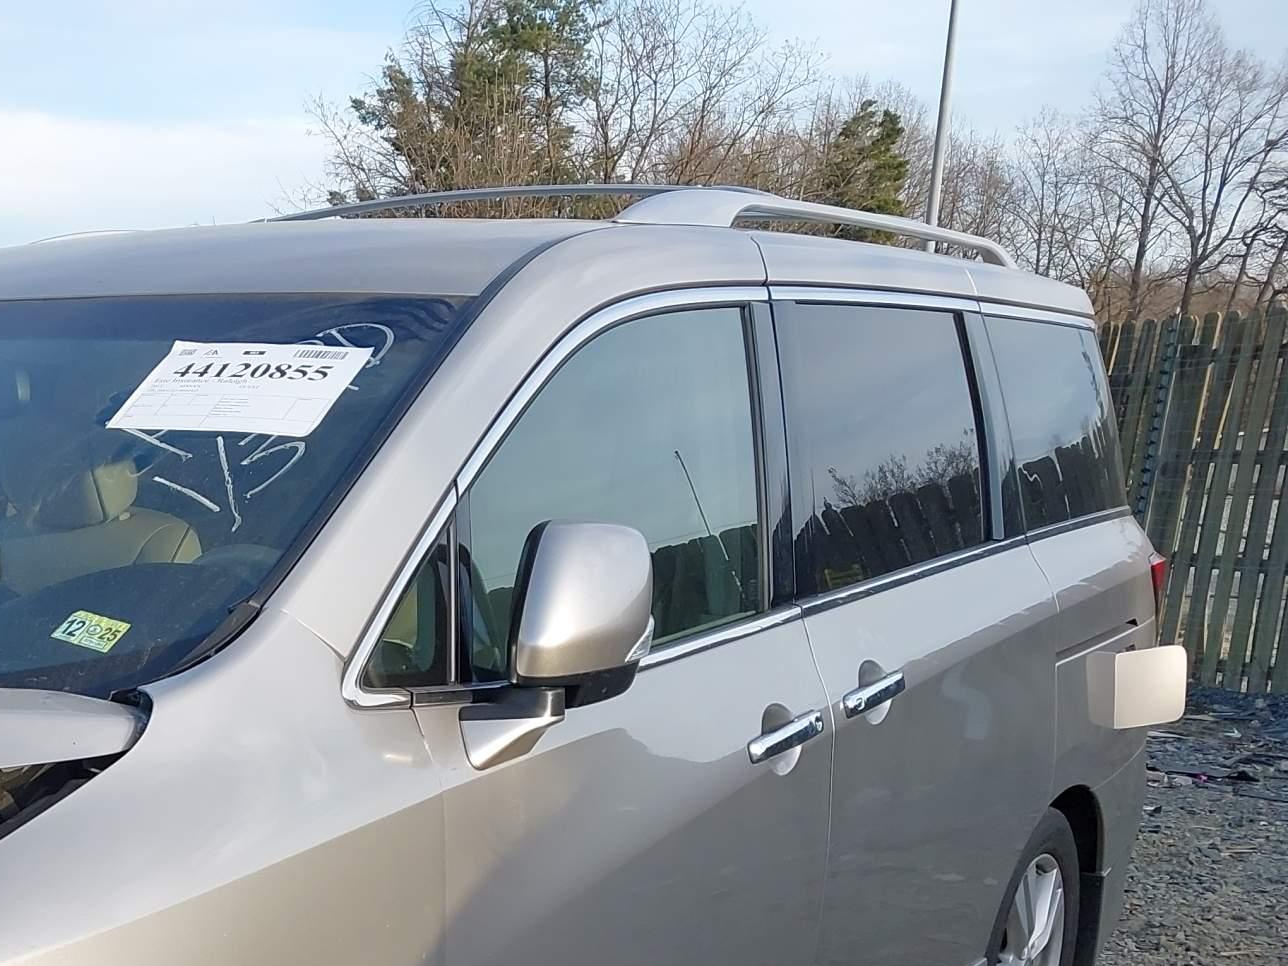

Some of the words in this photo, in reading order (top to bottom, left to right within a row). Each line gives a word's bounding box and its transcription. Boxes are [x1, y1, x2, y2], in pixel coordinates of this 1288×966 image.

[173, 362, 334, 381] 44120855
[62, 618, 86, 637] 12
[98, 627, 121, 641] 25
